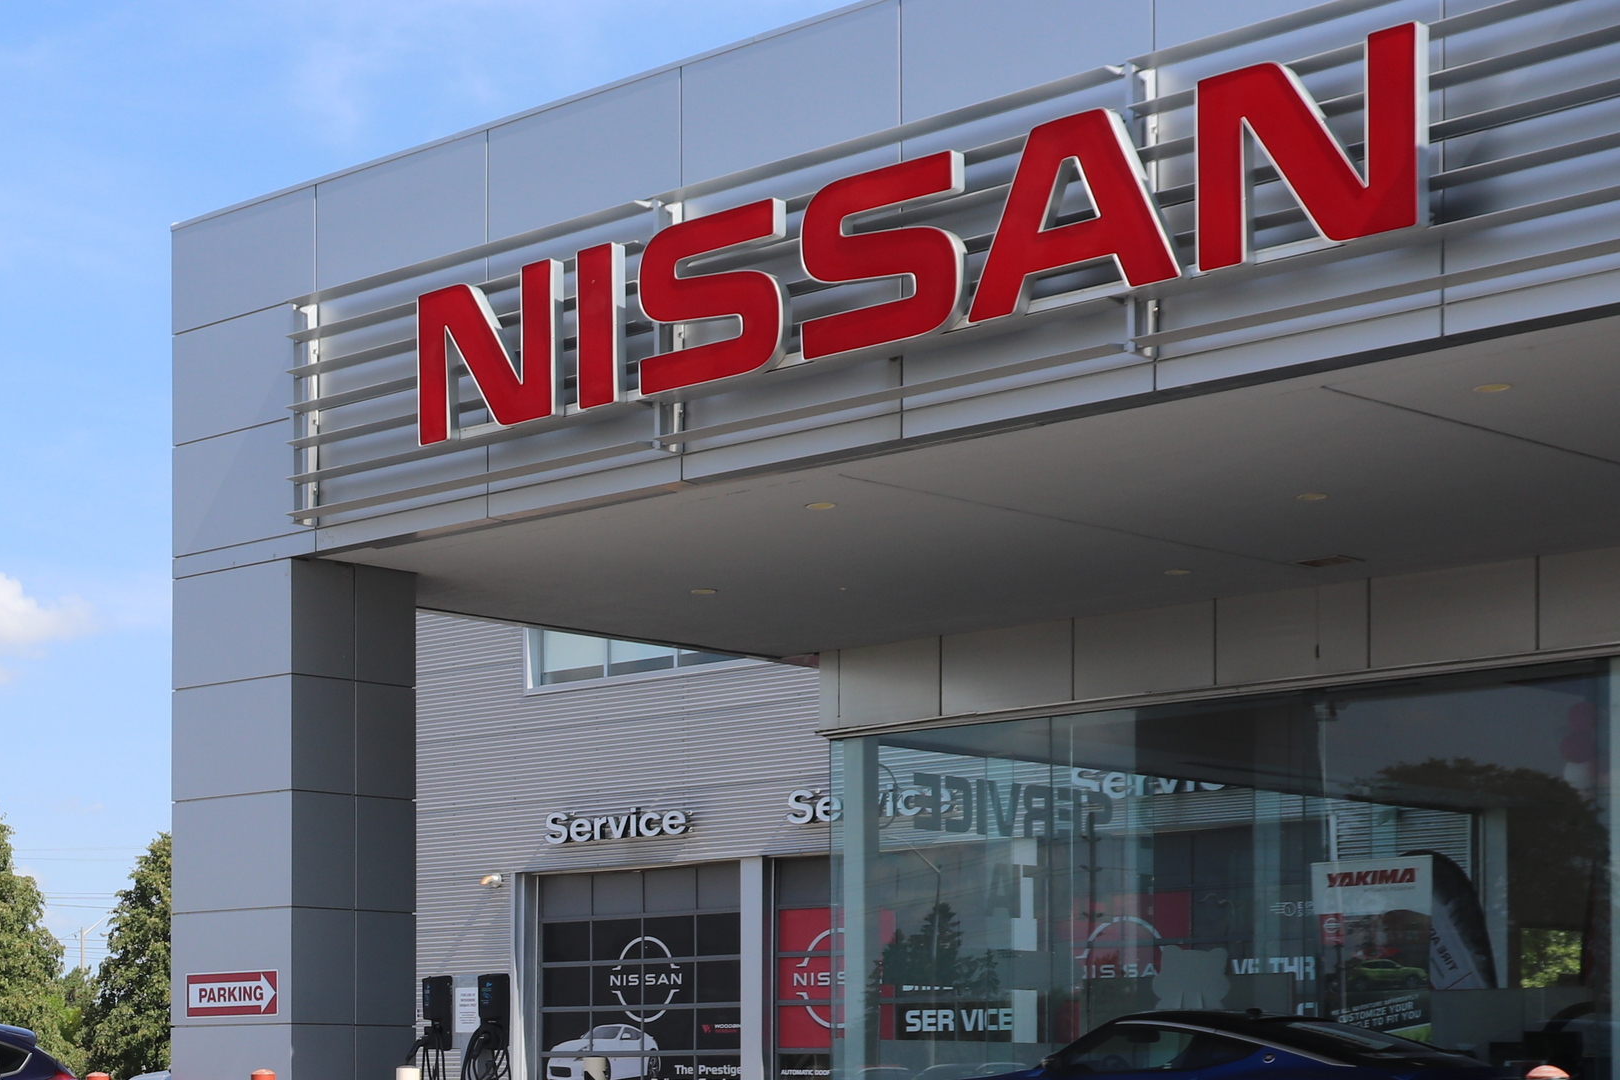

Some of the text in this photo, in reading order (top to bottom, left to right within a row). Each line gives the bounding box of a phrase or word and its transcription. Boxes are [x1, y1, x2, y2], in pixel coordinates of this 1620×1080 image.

[416, 20, 1430, 447] NISSAN
[544, 807, 687, 844] Service
[1327, 867, 1416, 888] YAKIMA
[609, 973, 682, 987] NISSAN
[198, 985, 264, 1003] PARKING
[905, 1008, 1013, 1032] SERVICE
[1338, 1001, 1414, 1023] CUSTOMIZE YOUR
[1372, 1016, 1384, 1026] TO
[1386, 1014, 1400, 1024] FIT
[1402, 1010, 1422, 1021] YOU
[674, 1064, 741, 1076] The Prestige
